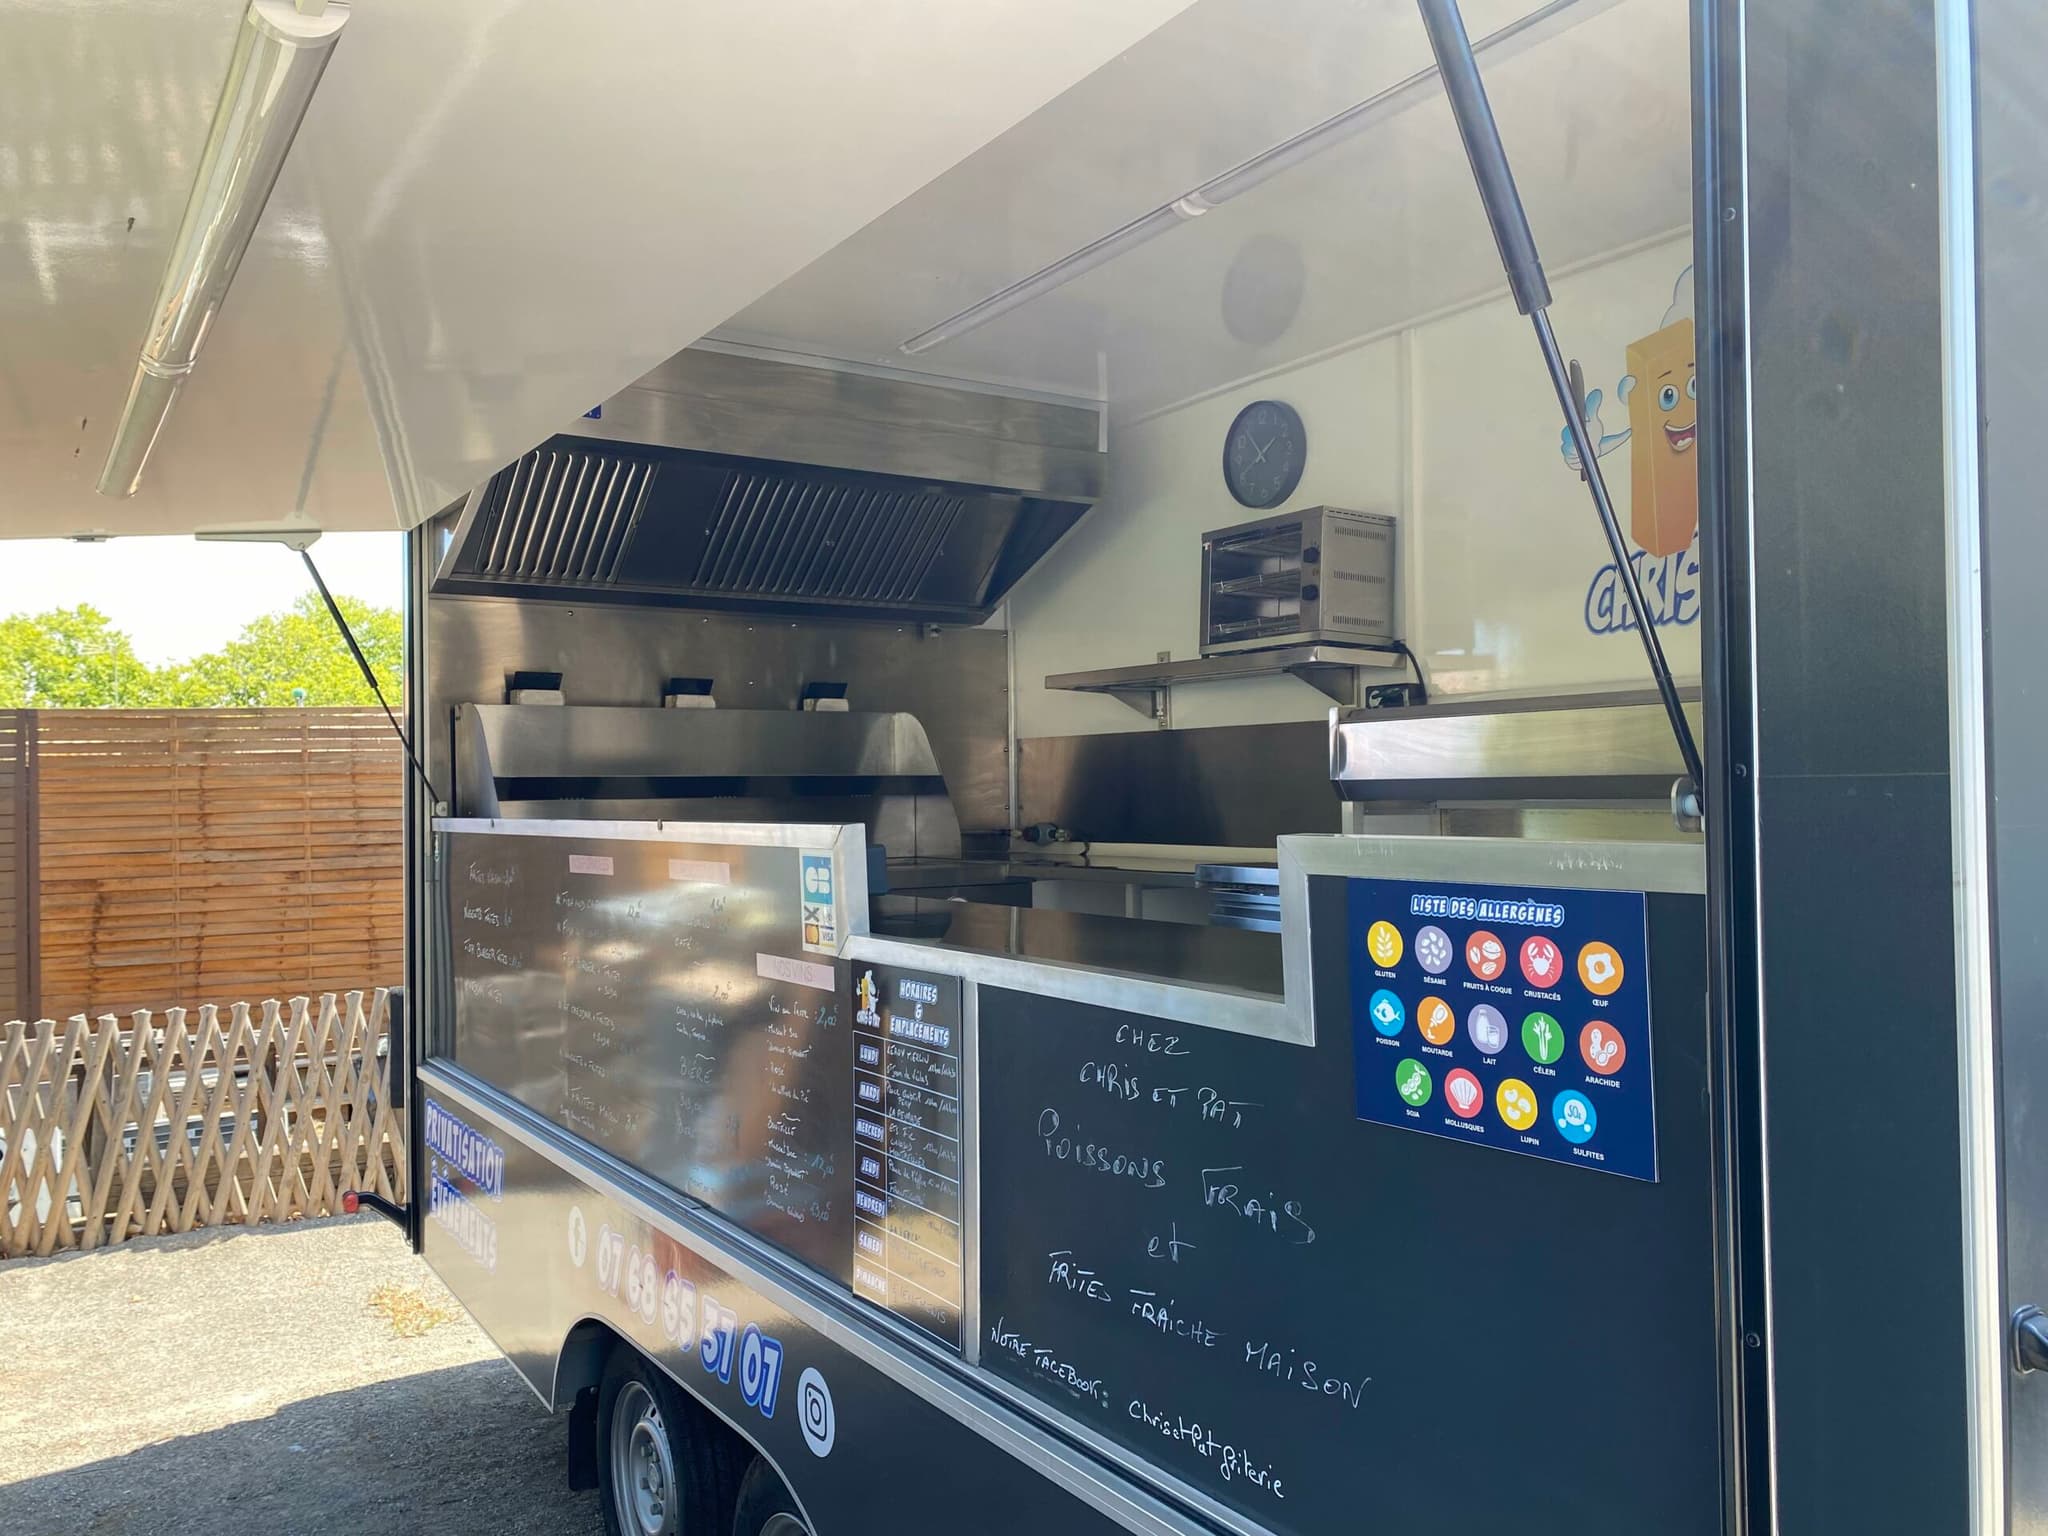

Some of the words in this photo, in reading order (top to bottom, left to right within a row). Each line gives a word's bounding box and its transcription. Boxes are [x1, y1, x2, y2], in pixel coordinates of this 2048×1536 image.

[1411, 895, 1448, 916] LISTE
[1450, 897, 1476, 920] DES
[1375, 970, 1396, 979] GLUTEN
[1424, 976, 1446, 986] SÉSAME
[899, 978, 938, 1005] HORAIRES
[1463, 982, 1484, 991] FRUITS
[1491, 986, 1513, 995] COQUE
[1524, 990, 1561, 1001] CRUSTACÉS
[1592, 999, 1609, 1007] ŒUF
[889, 1015, 950, 1048] EMPLACEMENTS
[1116, 1024, 1190, 1055] CHEZ
[1376, 1037, 1400, 1047] POISSON
[859, 1044, 879, 1065] LUNDI
[1422, 1046, 1453, 1058] MOUTARDE
[1483, 1057, 1496, 1065] LAIT
[1533, 1065, 1556, 1076] CÉLERI
[858, 1081, 880, 1103] MARDI
[1585, 1075, 1621, 1088] ARACHIDE
[1152, 1087, 1189, 1108] ET
[1197, 1087, 1264, 1128] PAT
[856, 1118, 884, 1143] MERCREDI
[1444, 1118, 1485, 1133] MOLLUSQUES
[425, 1098, 504, 1203] PRIVATISATION
[1520, 1135, 1540, 1146] LUPIN
[1573, 1148, 1604, 1161] SULFITES
[860, 1156, 881, 1179] JEUDI
[856, 1190, 887, 1218] VENDREDI
[858, 1230, 884, 1257] SAMEDI
[598, 1223, 625, 1298] 07
[626, 1244, 658, 1325] 68
[738, 1322, 783, 1419] 07
[991, 1317, 1032, 1358] NOTRE
